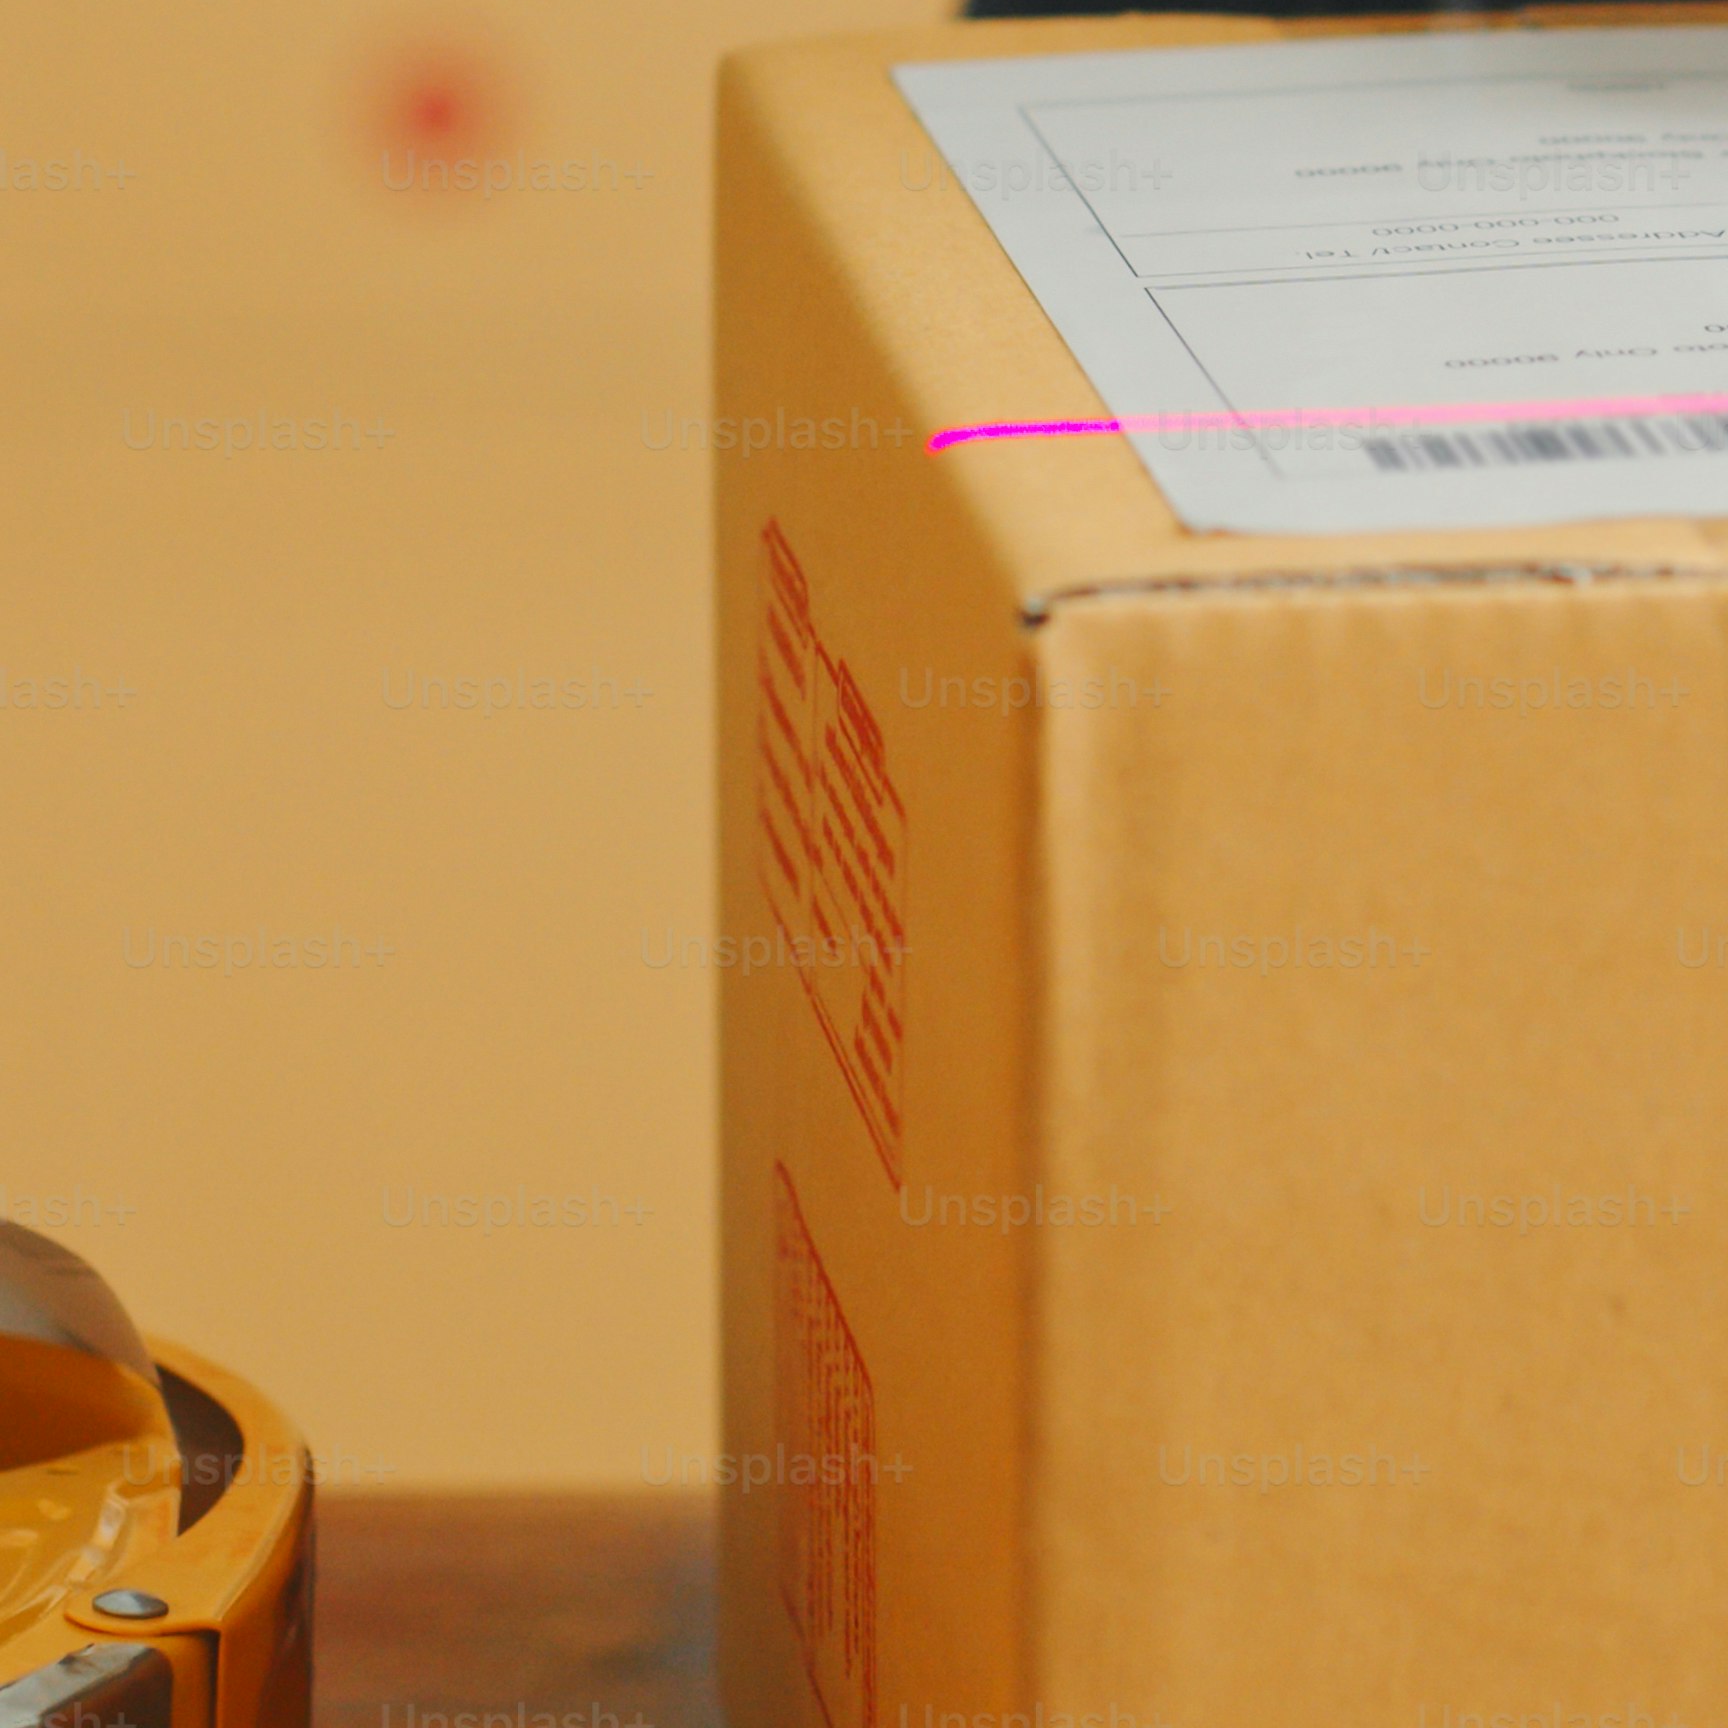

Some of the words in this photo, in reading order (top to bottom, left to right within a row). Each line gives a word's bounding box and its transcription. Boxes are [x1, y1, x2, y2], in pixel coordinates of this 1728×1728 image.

[1371, 213, 1621, 238] 000-000-0000
[1531, 228, 1726, 245] Addressee
[1444, 353, 1561, 370] 90000
[1574, 347, 1659, 360] Only
